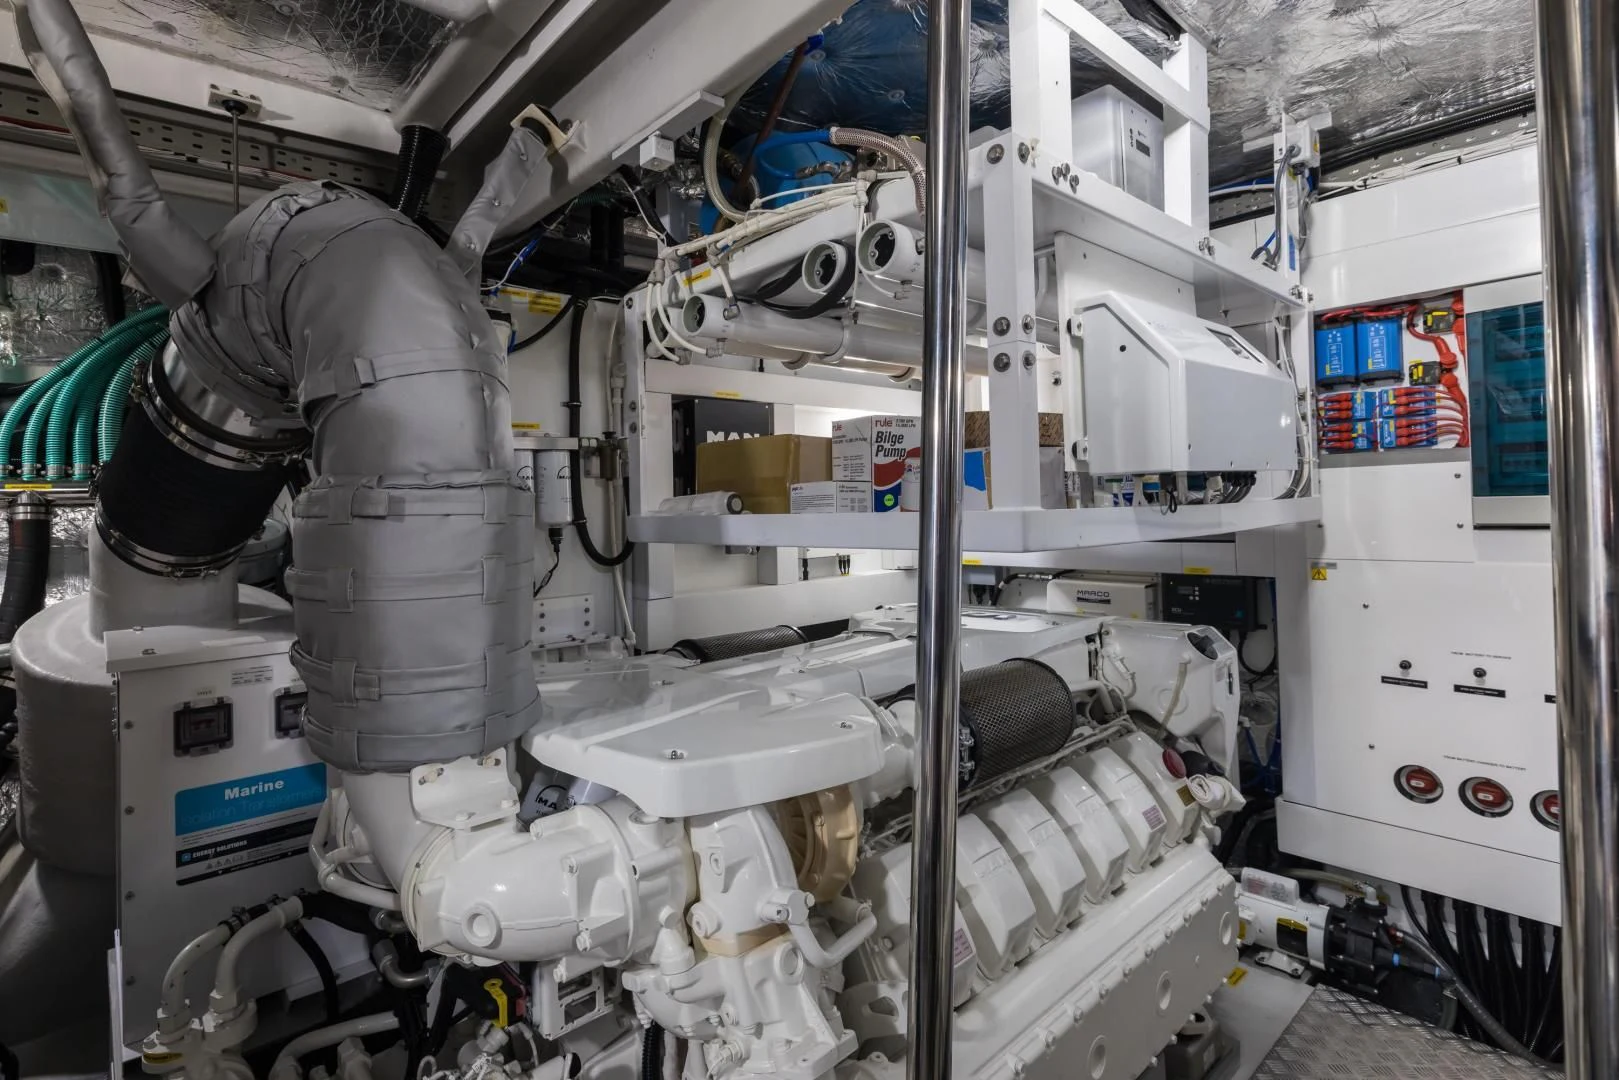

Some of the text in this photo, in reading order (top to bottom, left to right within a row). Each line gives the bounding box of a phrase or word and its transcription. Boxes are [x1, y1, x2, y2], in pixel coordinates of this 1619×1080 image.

[874, 417, 893, 428] rule
[875, 430, 904, 446] Bilge
[875, 444, 907, 460] Pump
[1076, 589, 1110, 598] MARCO
[224, 779, 285, 801] Marine
